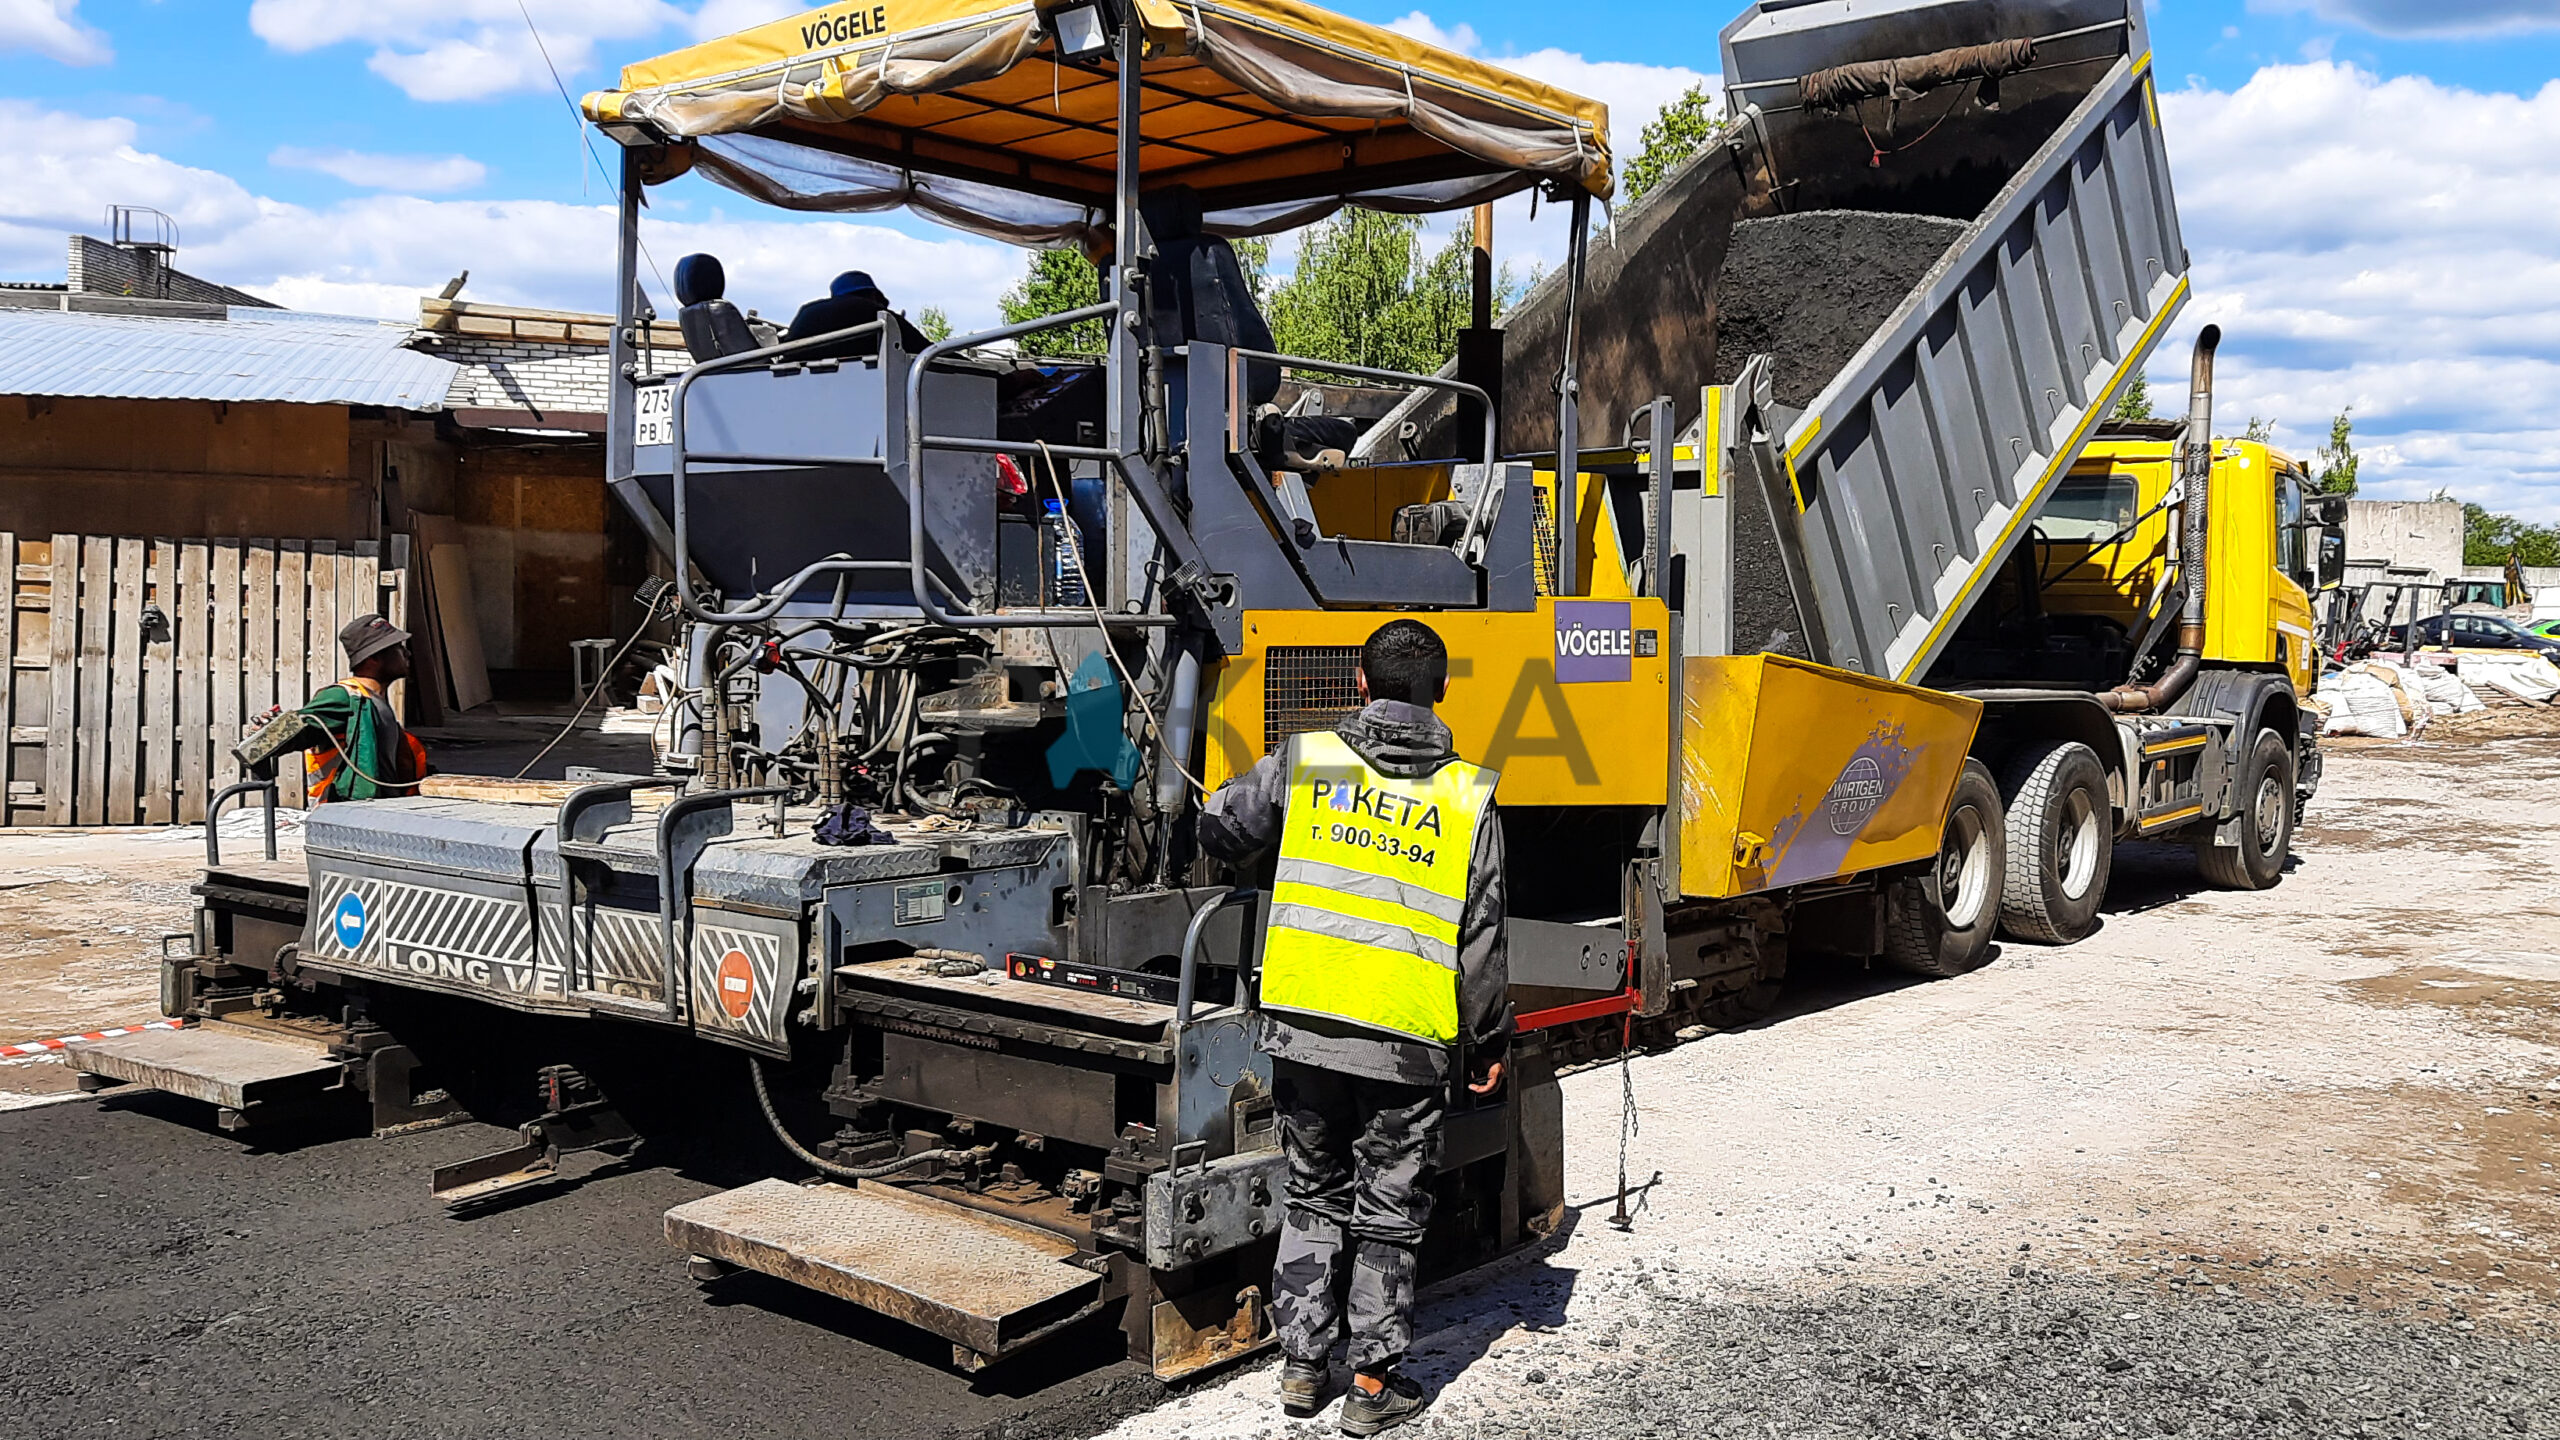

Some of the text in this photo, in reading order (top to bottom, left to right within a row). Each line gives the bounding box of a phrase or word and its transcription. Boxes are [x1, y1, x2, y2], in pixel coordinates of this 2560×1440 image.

[801, 5, 886, 49] VÖGELE
[1556, 623, 1630, 656] VÖGELE
[1831, 799, 1876, 814] GROUP
[1834, 779, 1884, 798] WIRTGEN
[1331, 824, 1435, 867] 900-33-94
[389, 945, 491, 986] LONG
